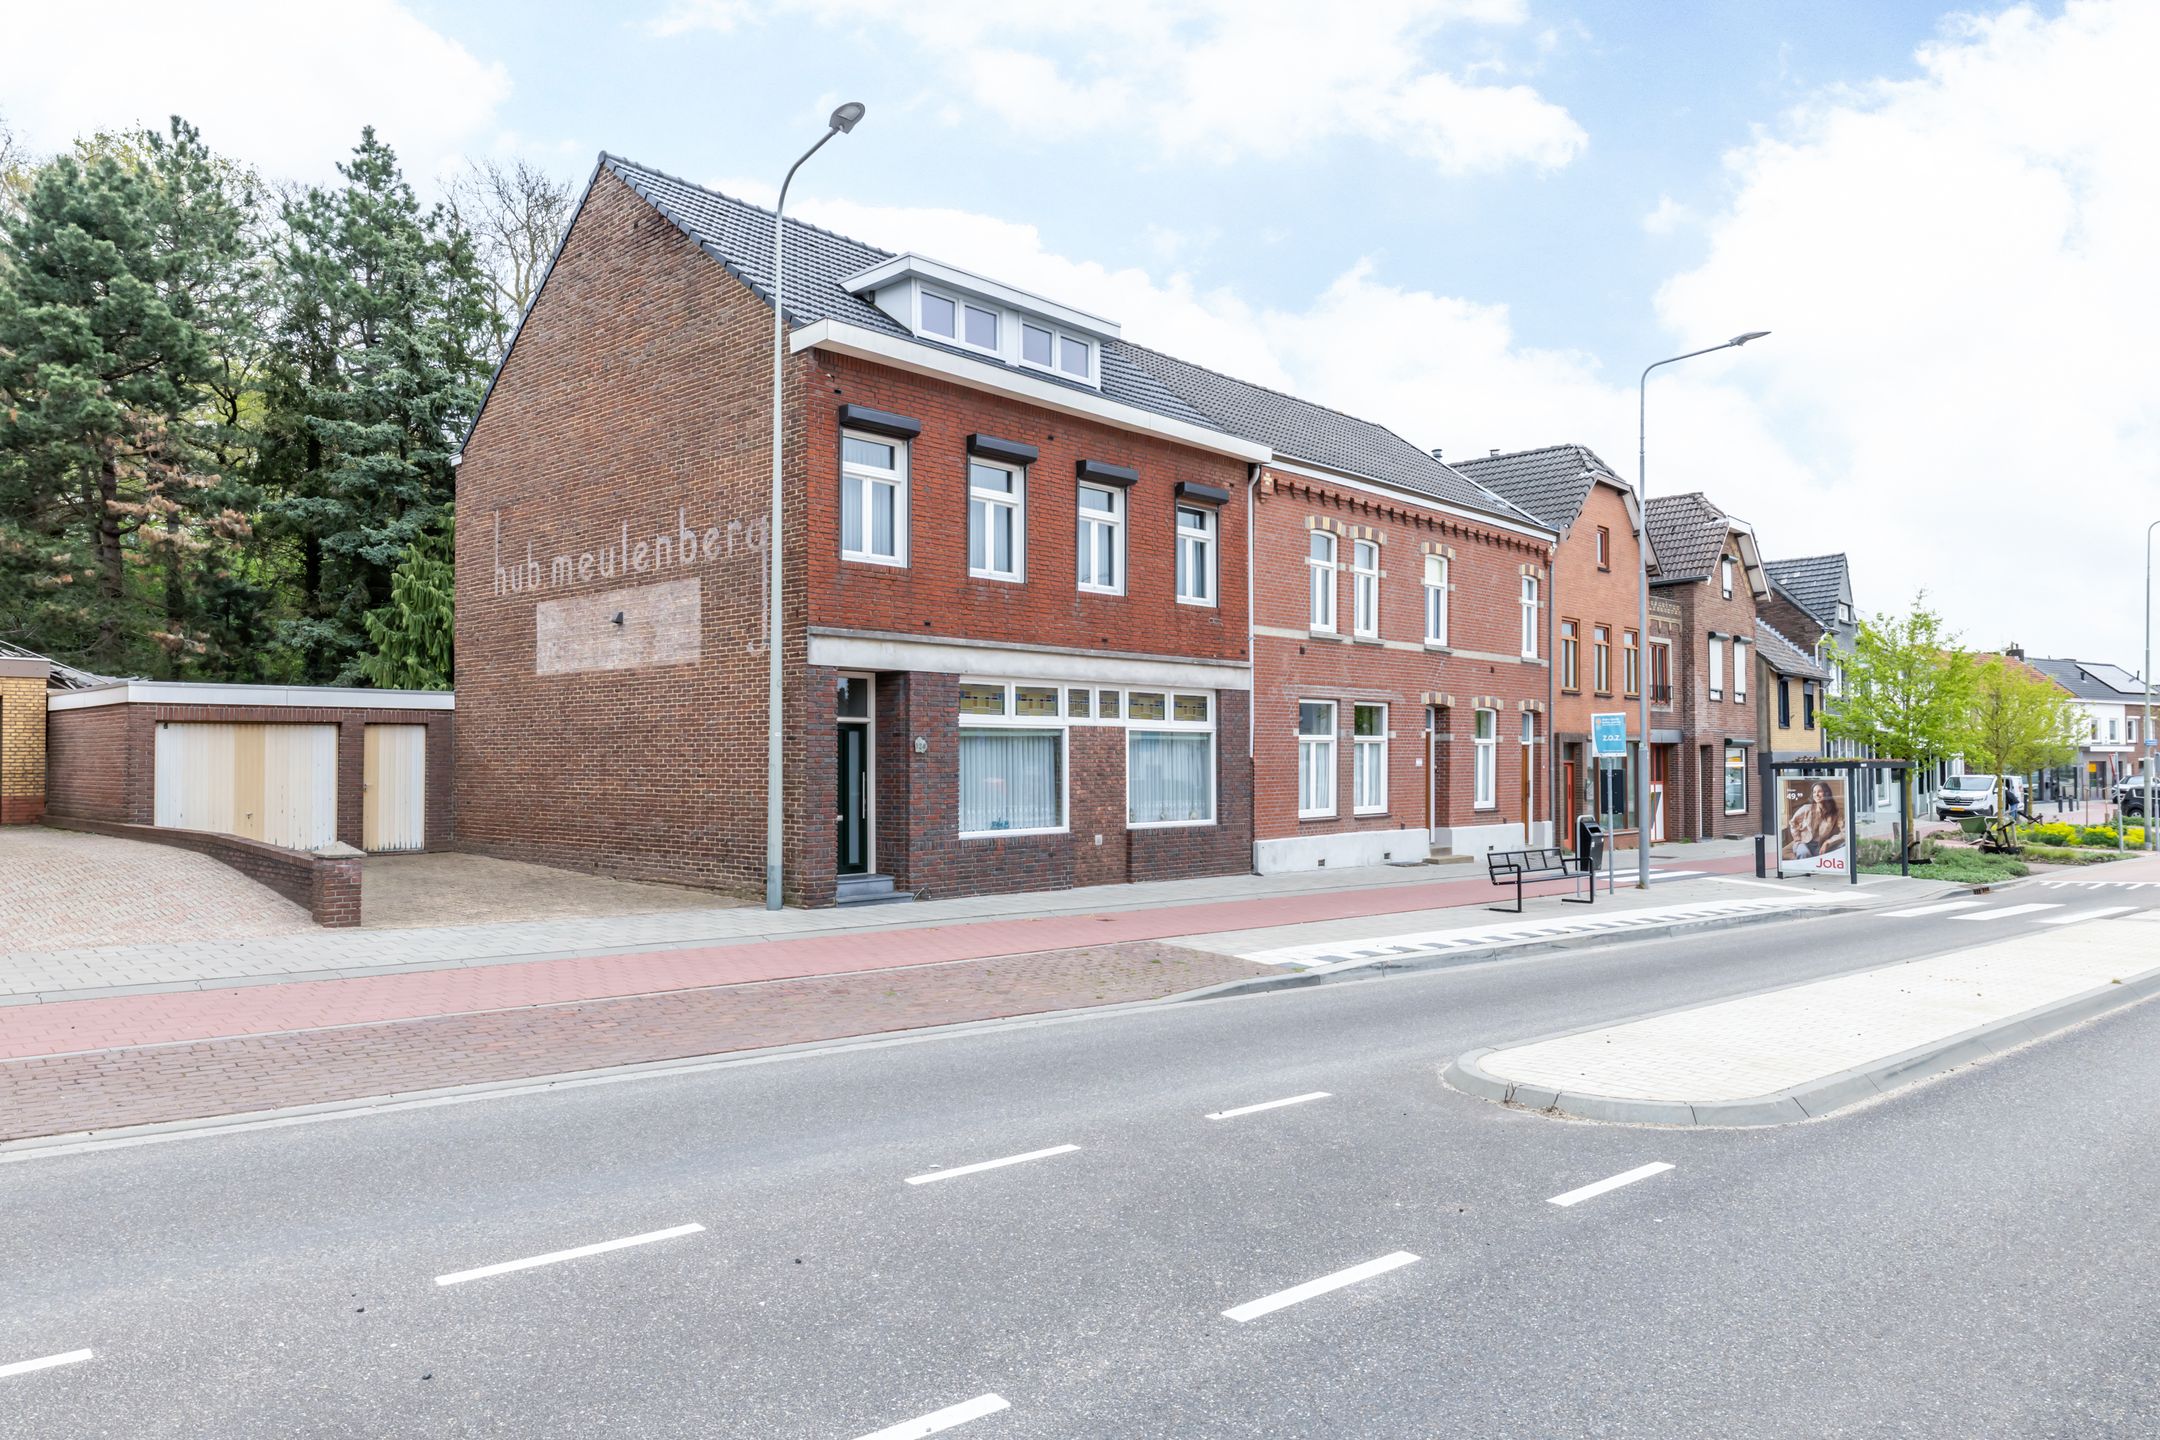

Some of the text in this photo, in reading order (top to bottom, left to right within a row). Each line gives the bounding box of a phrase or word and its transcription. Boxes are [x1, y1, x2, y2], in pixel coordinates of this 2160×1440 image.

[494, 506, 771, 656] hub meulenberg
[1816, 858, 1845, 869] Jola
